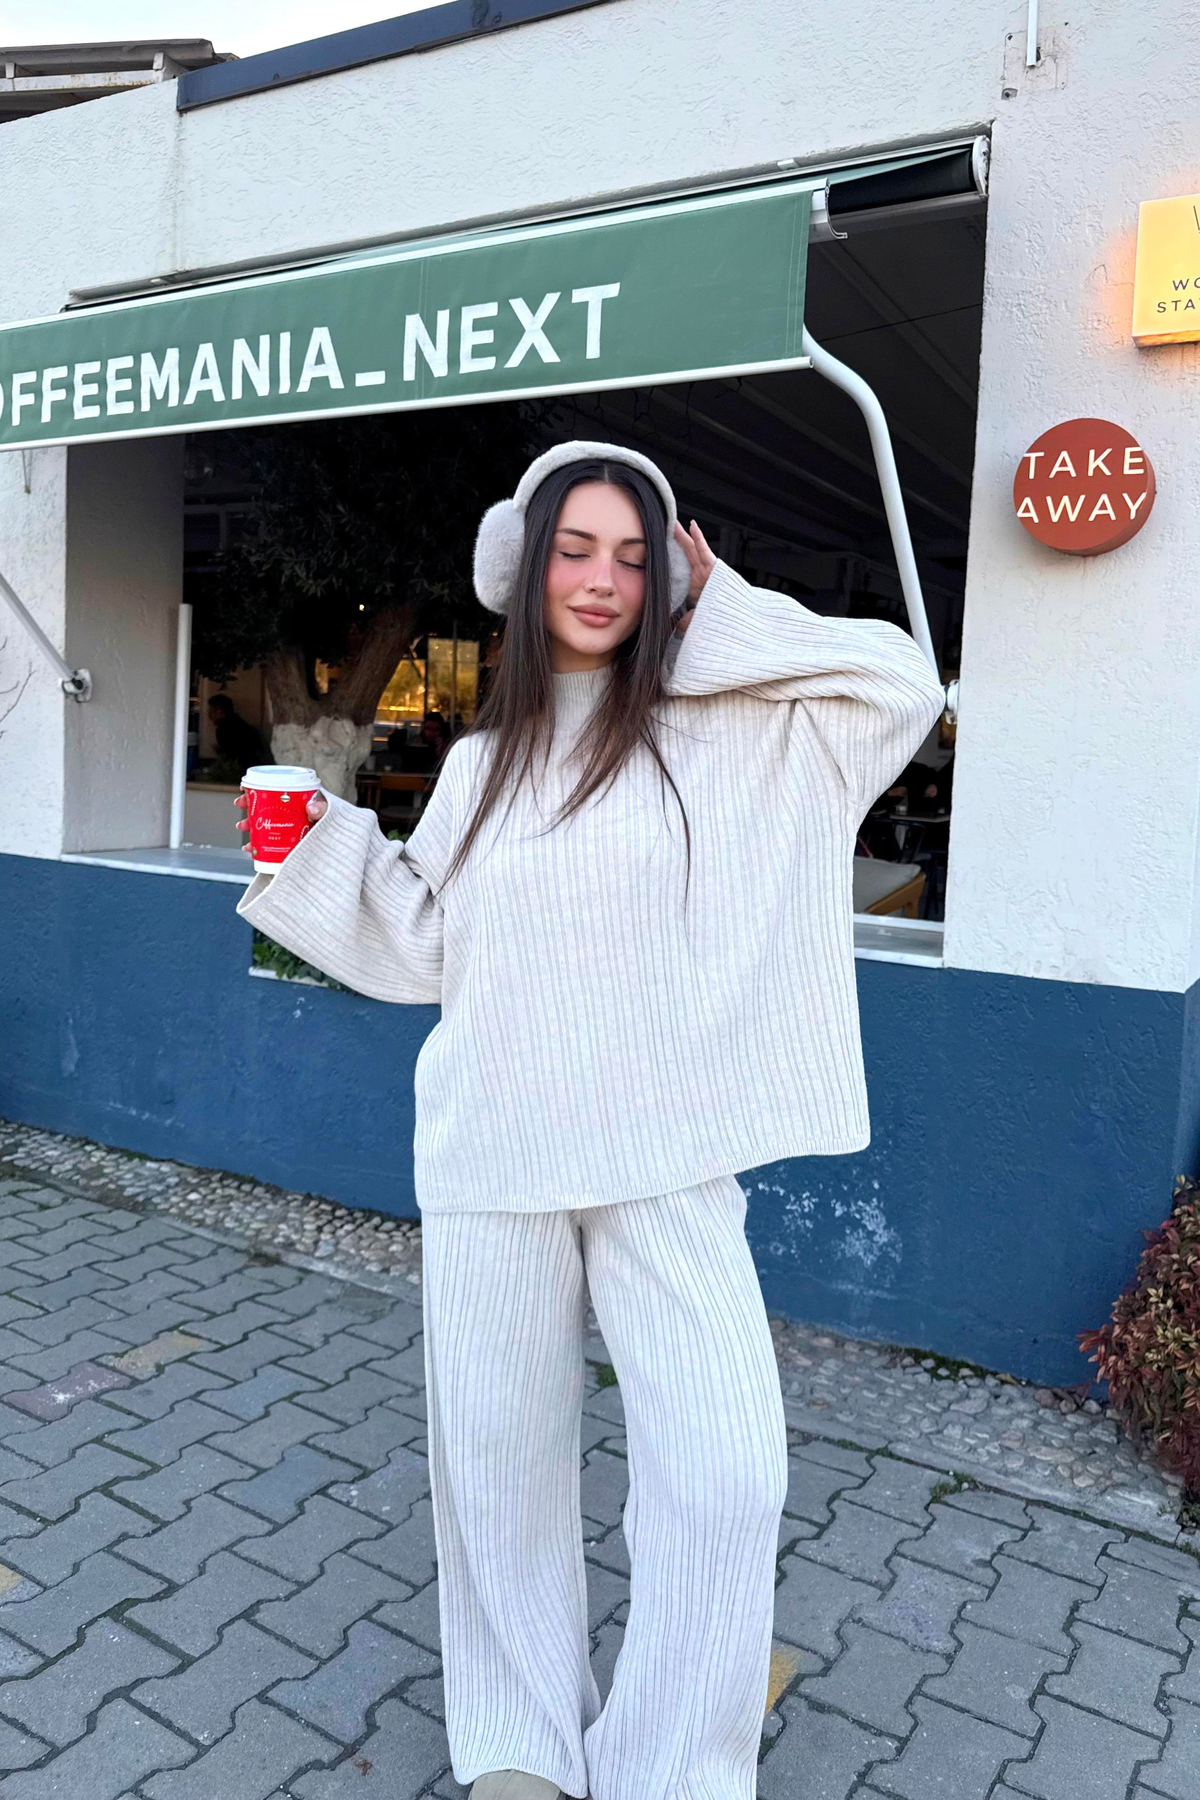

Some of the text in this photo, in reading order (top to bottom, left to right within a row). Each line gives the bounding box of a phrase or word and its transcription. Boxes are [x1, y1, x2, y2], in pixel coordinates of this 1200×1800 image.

[1157, 298, 1200, 313] STA
[1023, 447, 1145, 480] TAKE
[1017, 492, 1147, 524] AWAY
